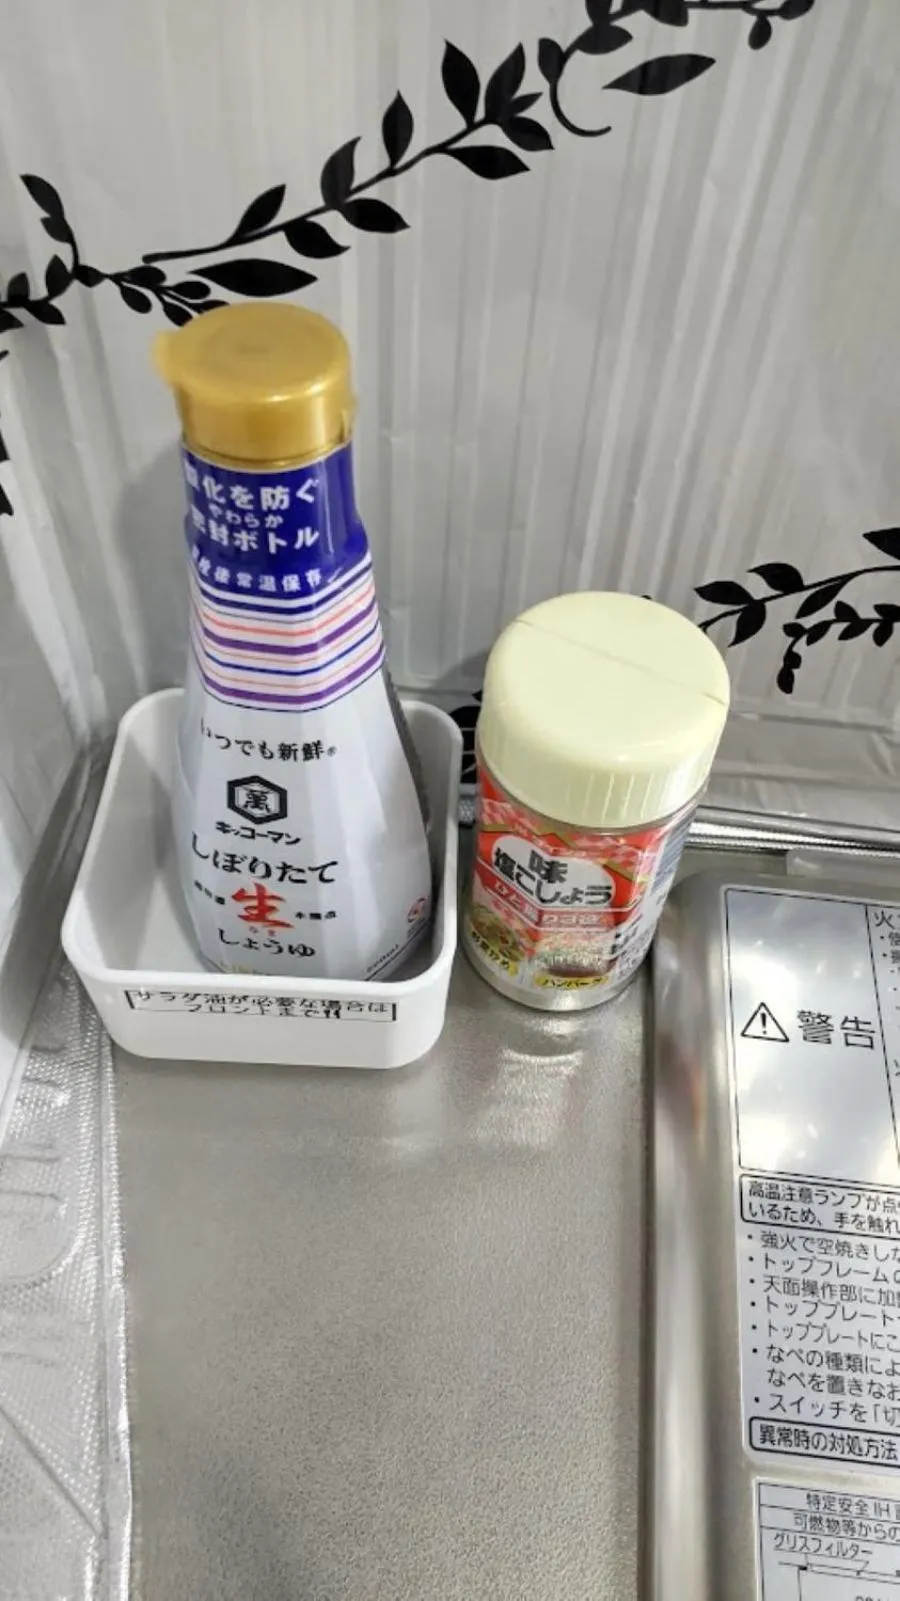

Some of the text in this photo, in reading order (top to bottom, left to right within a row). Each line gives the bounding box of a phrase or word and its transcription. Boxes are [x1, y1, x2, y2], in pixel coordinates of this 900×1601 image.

[215, 820, 302, 846] キッコーマン
[191, 831, 339, 885] しぼりたて
[528, 849, 569, 884] 味
[493, 847, 613, 906] 塩こしょう
[231, 881, 295, 928] 生
[218, 928, 316, 957] しょうゆ
[797, 1009, 876, 1051] 警告
[749, 1180, 900, 1214] 高温注意ランプが点
[764, 1275, 900, 1308] 天面操作部に加
[767, 1297, 900, 1328] トッププレート
[760, 1423, 898, 1462] 異常時の対処方法
[774, 1532, 873, 1559] グリスフィルター
